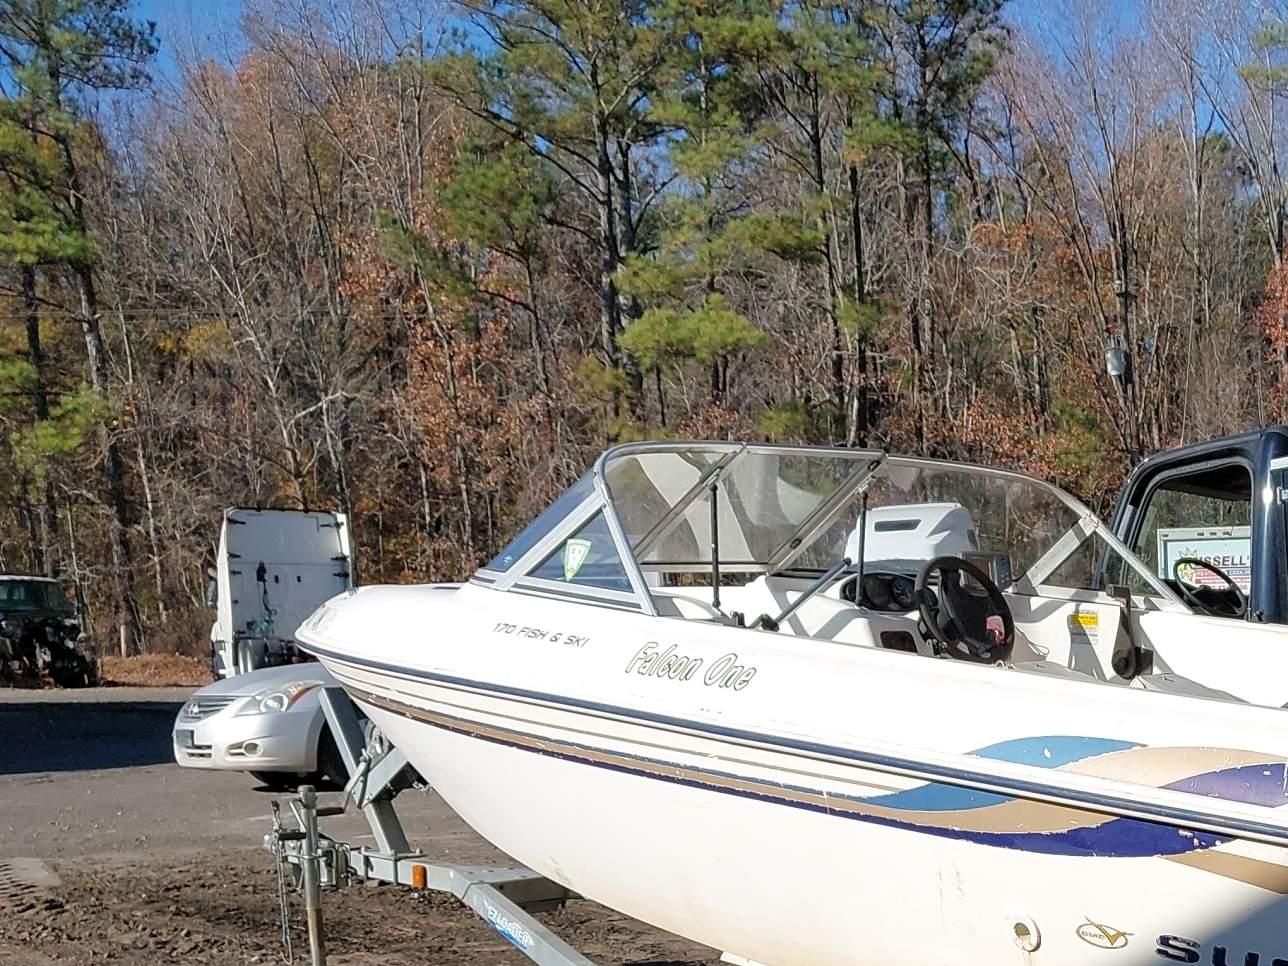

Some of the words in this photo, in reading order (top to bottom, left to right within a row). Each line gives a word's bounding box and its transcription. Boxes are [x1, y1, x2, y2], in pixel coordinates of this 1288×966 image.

[492, 622, 517, 634] 170
[516, 626, 550, 641] FISH
[548, 632, 563, 643] &
[563, 635, 590, 648] SKI
[624, 641, 704, 681] Falcon
[703, 653, 757, 691] One
